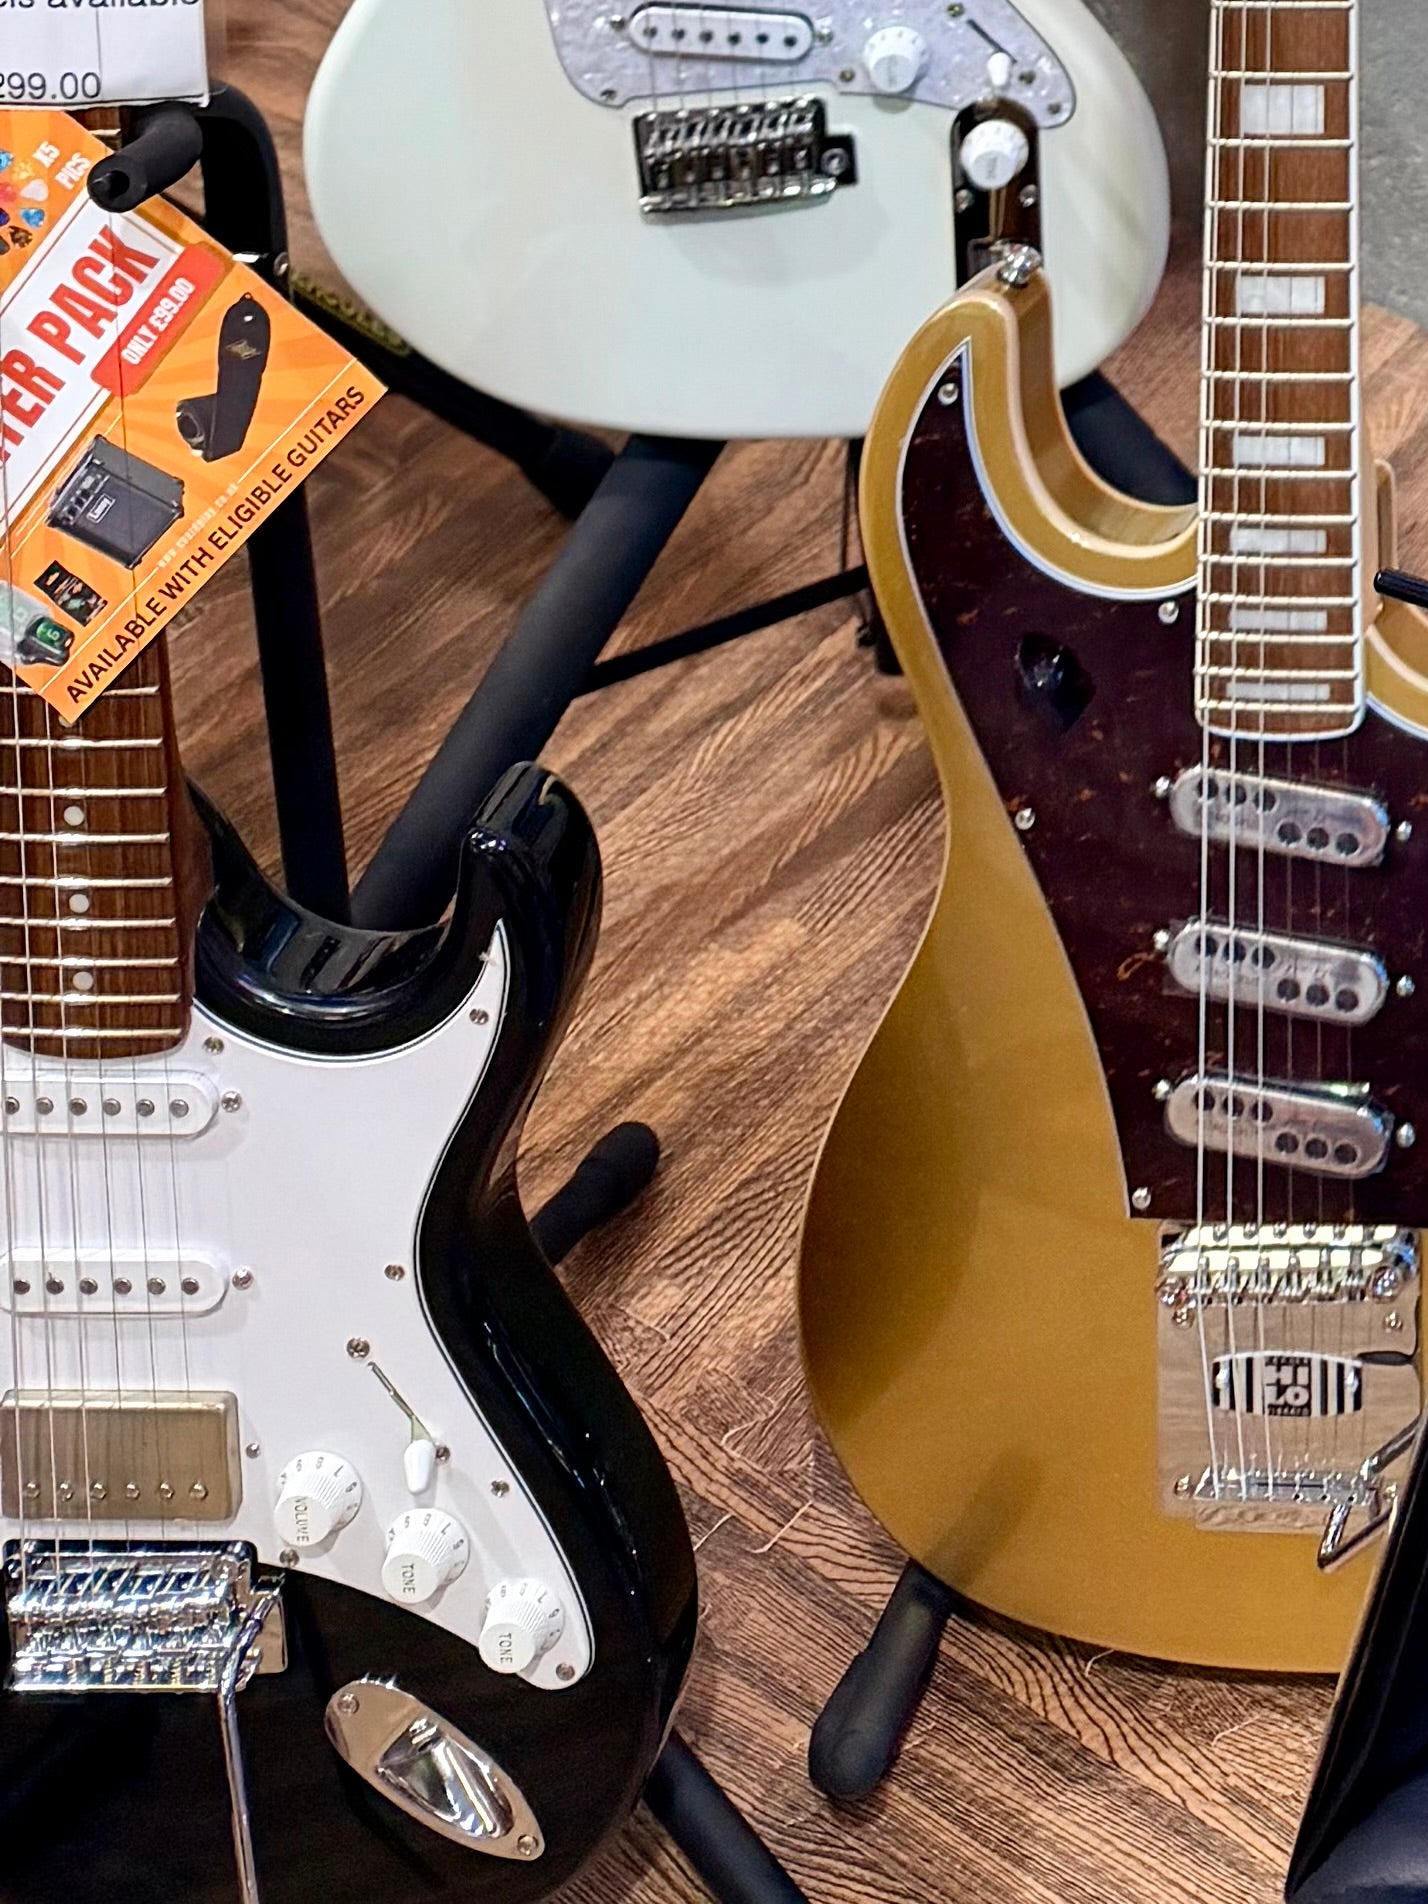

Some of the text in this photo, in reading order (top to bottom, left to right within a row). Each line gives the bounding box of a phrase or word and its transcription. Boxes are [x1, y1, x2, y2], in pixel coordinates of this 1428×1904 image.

[0, 70, 101, 101] 99.00
[54, 150, 93, 191] PICS
[26, 223, 161, 367] PACK
[120, 276, 197, 366] ONLY £99.00
[65, 596, 168, 706] AVAILABLE
[158, 546, 215, 608] WITH
[208, 462, 292, 552] ELIGIBLE
[286, 385, 366, 468] GUITARS
[400, 1562, 417, 1595] TONE
[498, 1631, 513, 1665] TONE
